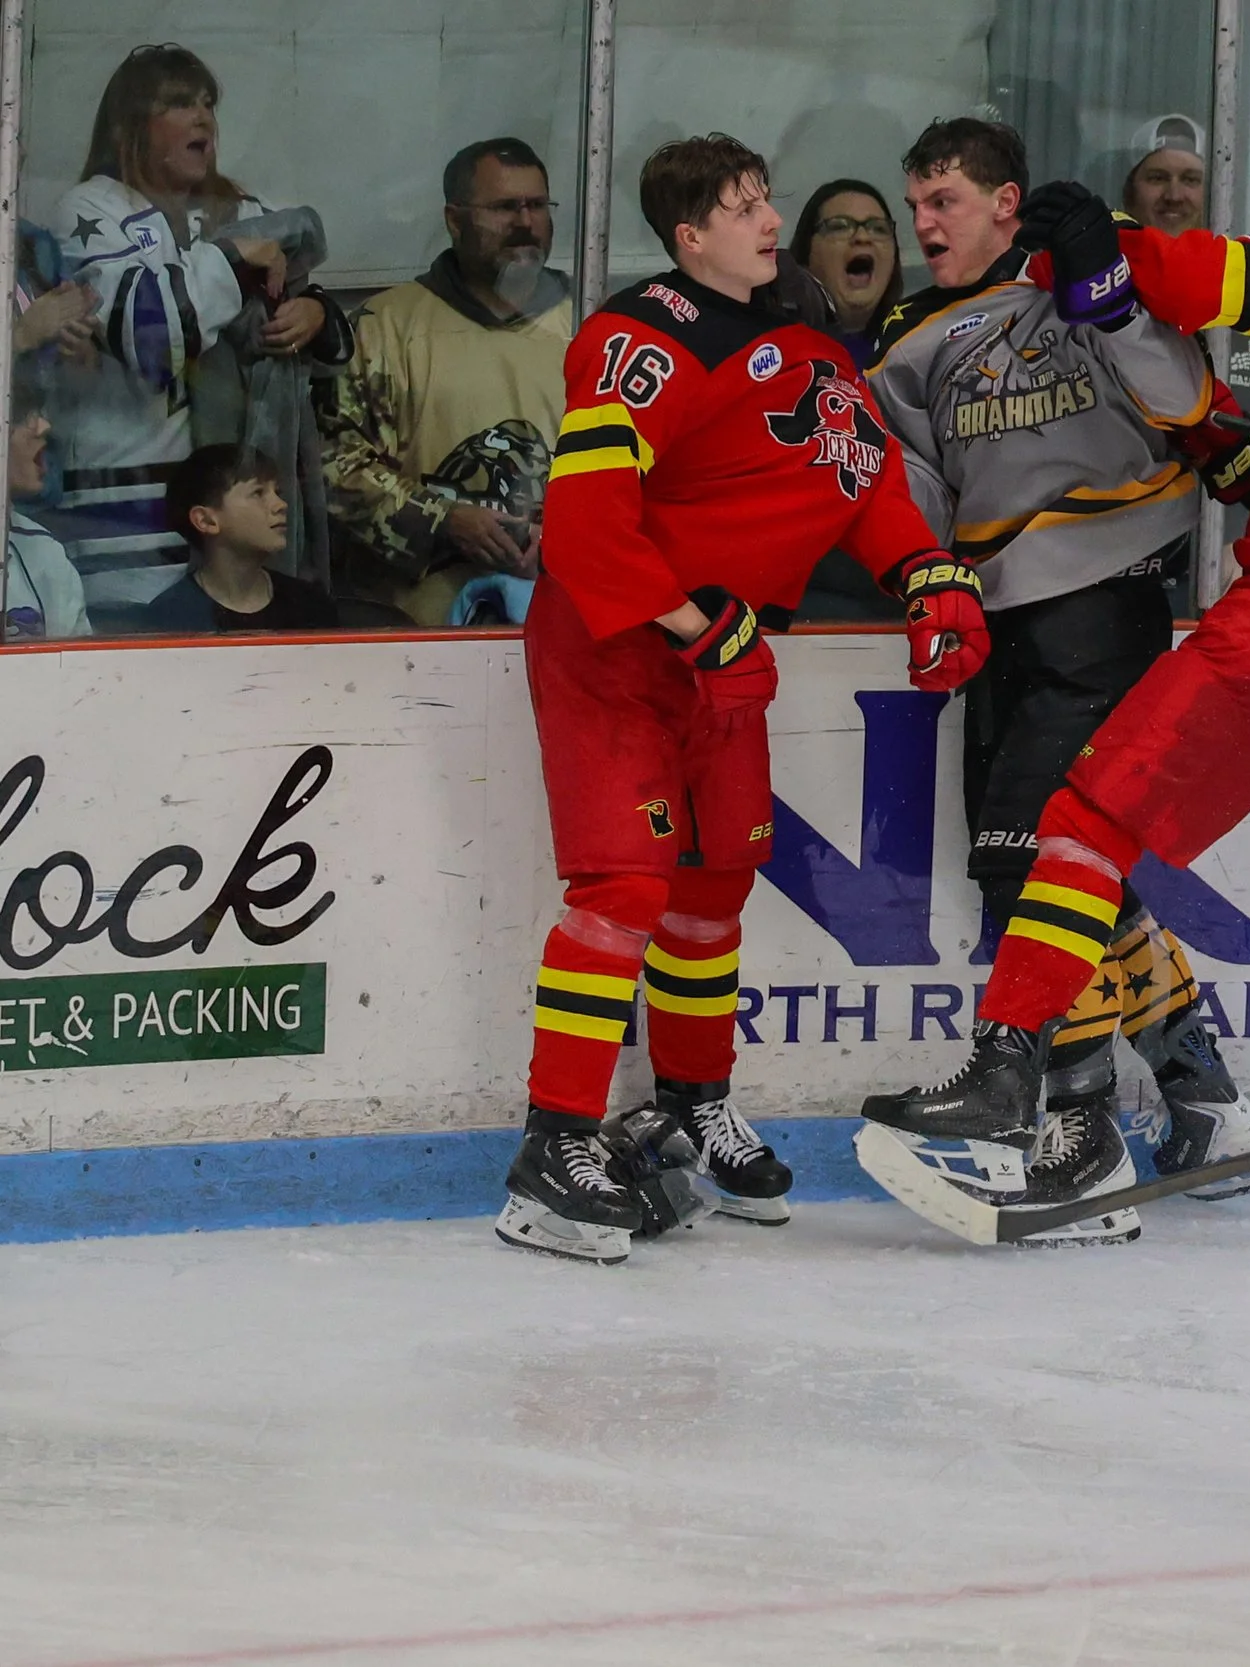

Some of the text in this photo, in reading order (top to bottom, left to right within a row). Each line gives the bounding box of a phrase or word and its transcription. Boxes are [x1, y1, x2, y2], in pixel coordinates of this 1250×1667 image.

[595, 332, 675, 409] 16
[751, 352, 780, 377] NAHL
[957, 377, 1096, 438] BRAHMAS
[64, 995, 94, 1042] &
[113, 984, 301, 1039] PACKING
[923, 1099, 964, 1114] BAUER
[540, 1171, 569, 1196] BAUER
[1072, 1159, 1101, 1186] BAUER
